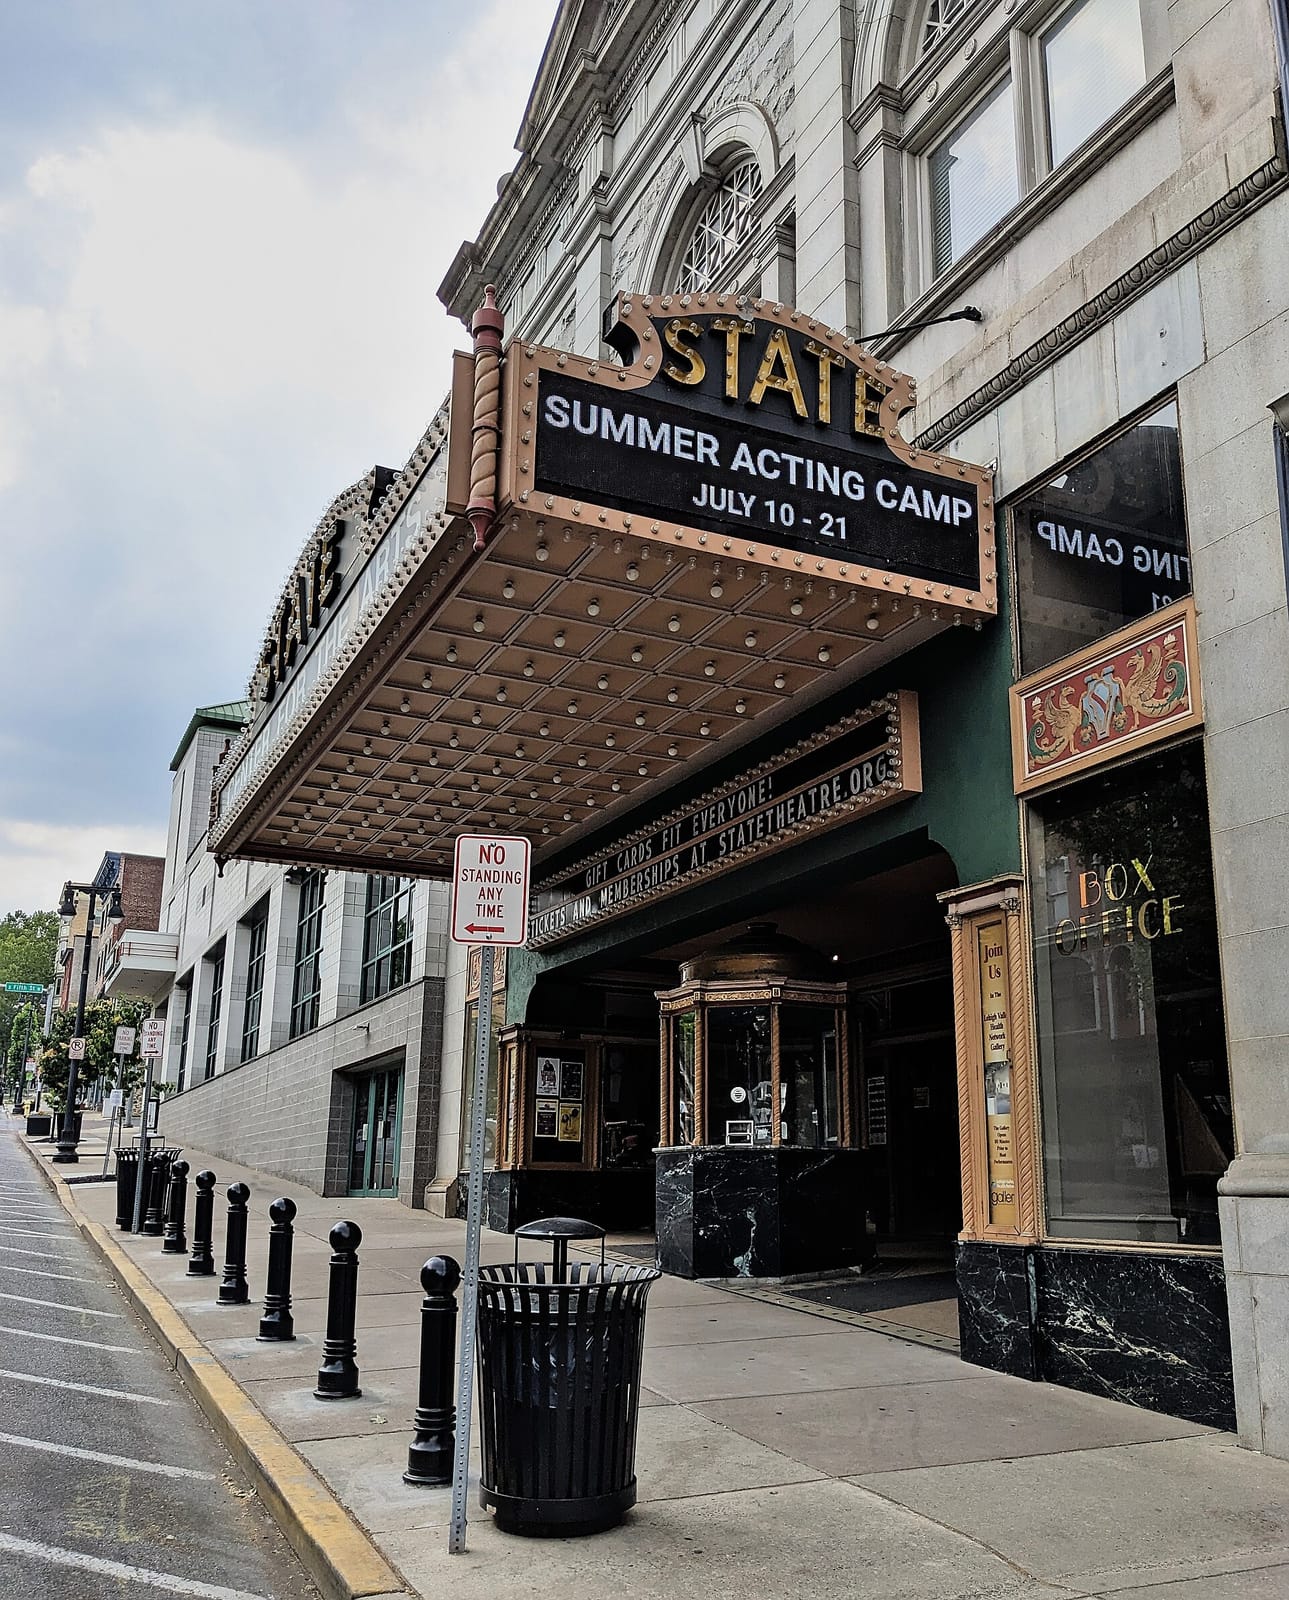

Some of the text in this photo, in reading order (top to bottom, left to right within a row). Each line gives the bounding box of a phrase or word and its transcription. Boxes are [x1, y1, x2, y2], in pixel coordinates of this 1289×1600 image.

[663, 318, 887, 439] STATE
[544, 394, 973, 527] SUMMER ACTING CAMP
[692, 483, 757, 518] JULY
[764, 500, 795, 527] 10
[819, 512, 847, 540] 21
[315, 610, 351, 680] THE
[359, 498, 422, 620] ARTS
[585, 776, 773, 888] GIFT CARDS FIT EVERYONE!
[479, 844, 506, 865] NO
[530, 753, 887, 938] TICKETS AND MEMBERSHIPS AT STATETHEATRE.ORG
[461, 868, 522, 885] STANDING
[1079, 854, 1156, 908] BOX
[478, 886, 504, 901] ANY
[475, 903, 505, 918] TIME
[1055, 894, 1185, 956] OFFICE
[983, 943, 1003, 963] Join
[988, 964, 1002, 979] Us
[148, 1021, 158, 1029] NO
[989, 1032, 1006, 1041] Network
[990, 1043, 1005, 1052] Gallery
